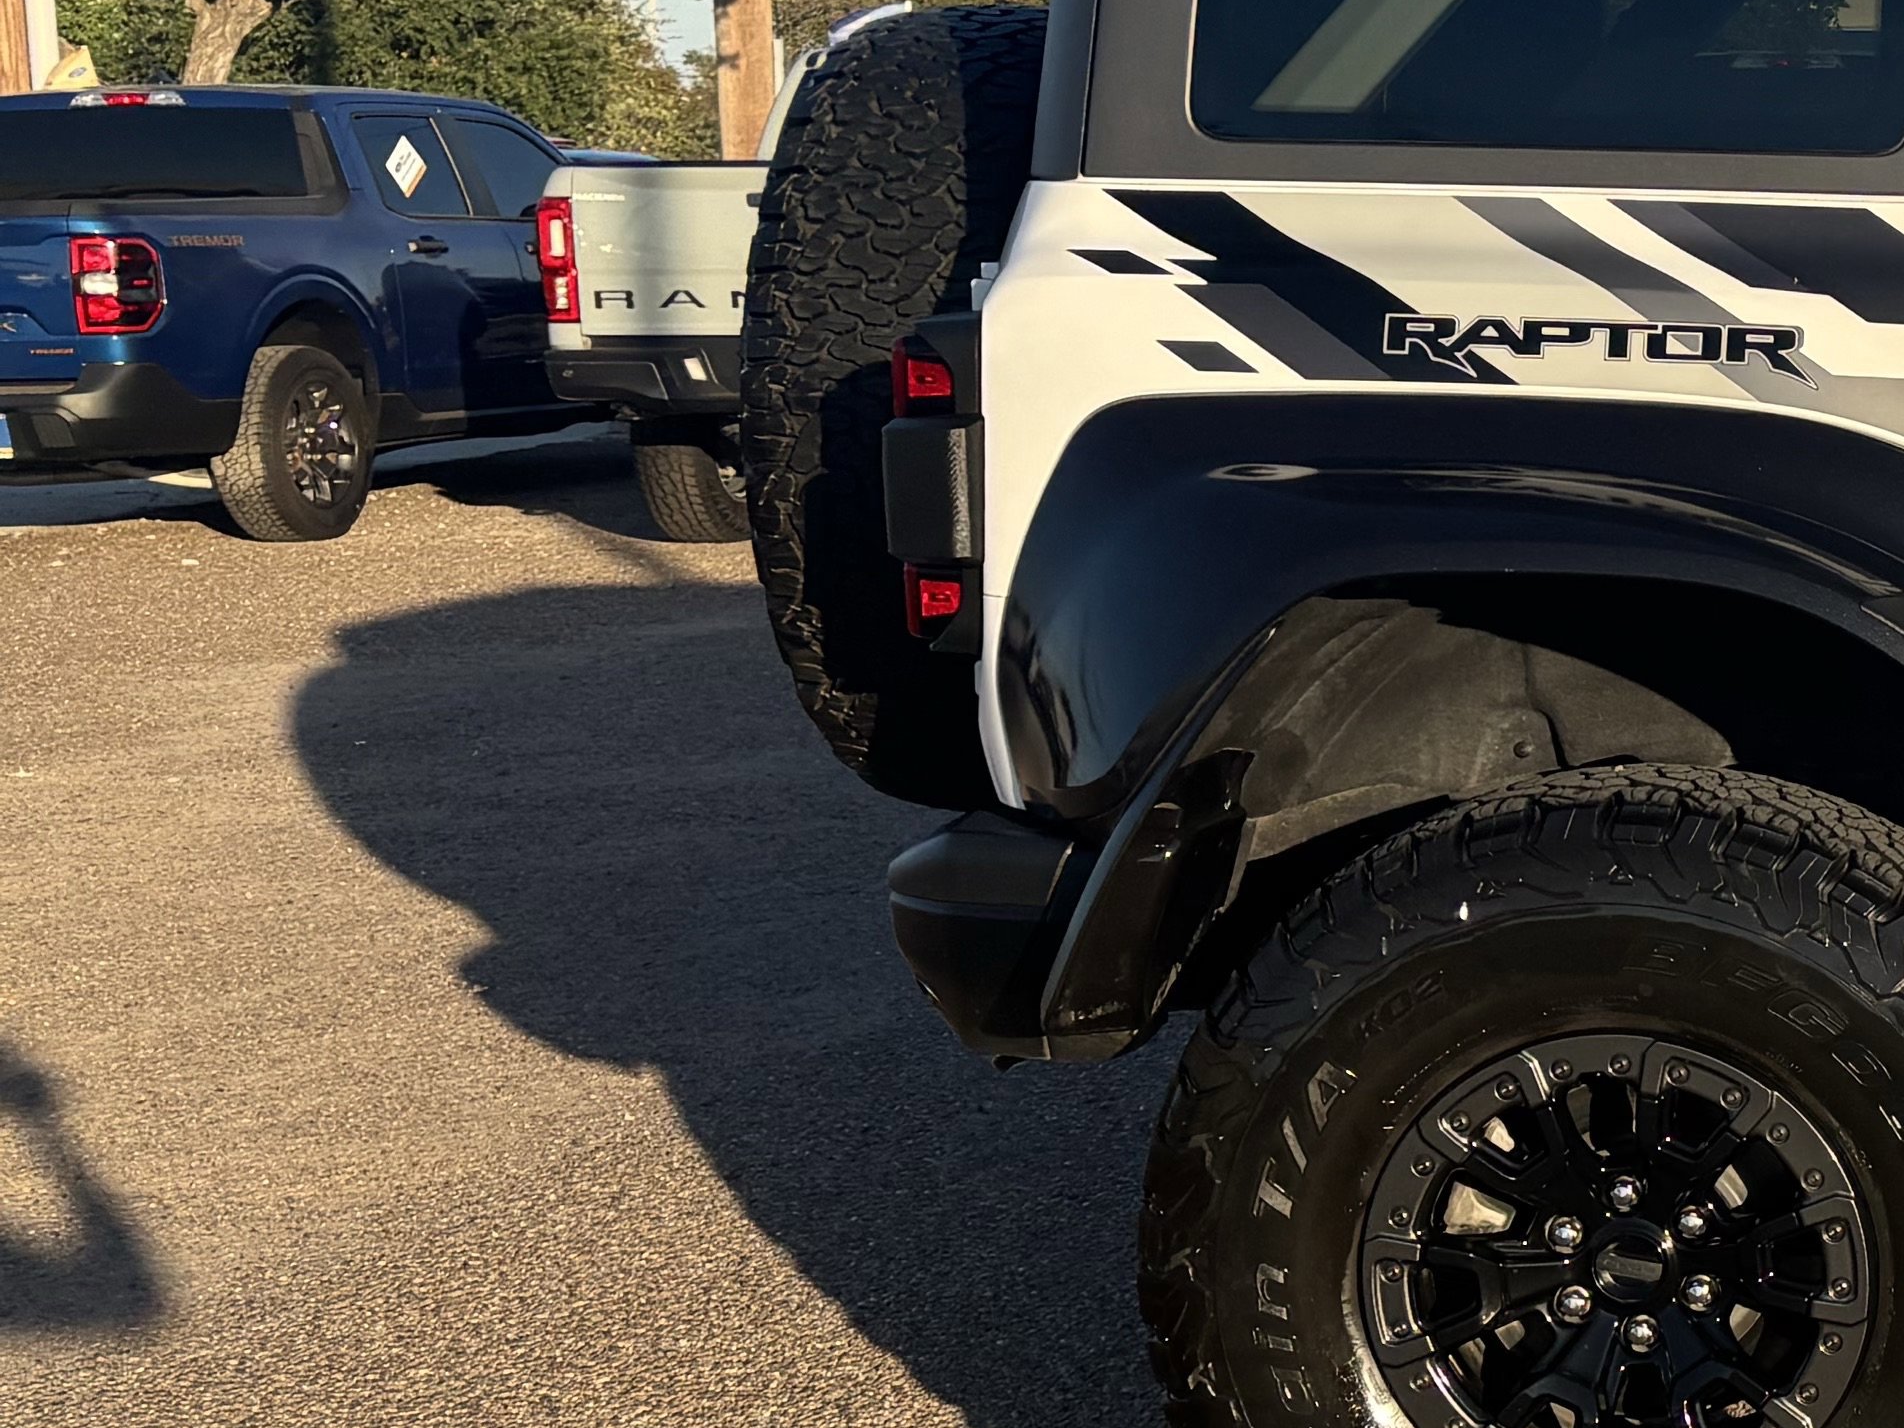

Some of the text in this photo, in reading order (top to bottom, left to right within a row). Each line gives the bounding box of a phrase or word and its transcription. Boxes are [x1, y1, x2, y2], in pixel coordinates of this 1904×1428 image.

[169, 235, 246, 247] TREMOR
[1382, 312, 1819, 390] RAPTOR
[1252, 1060, 1361, 1220] T/A
